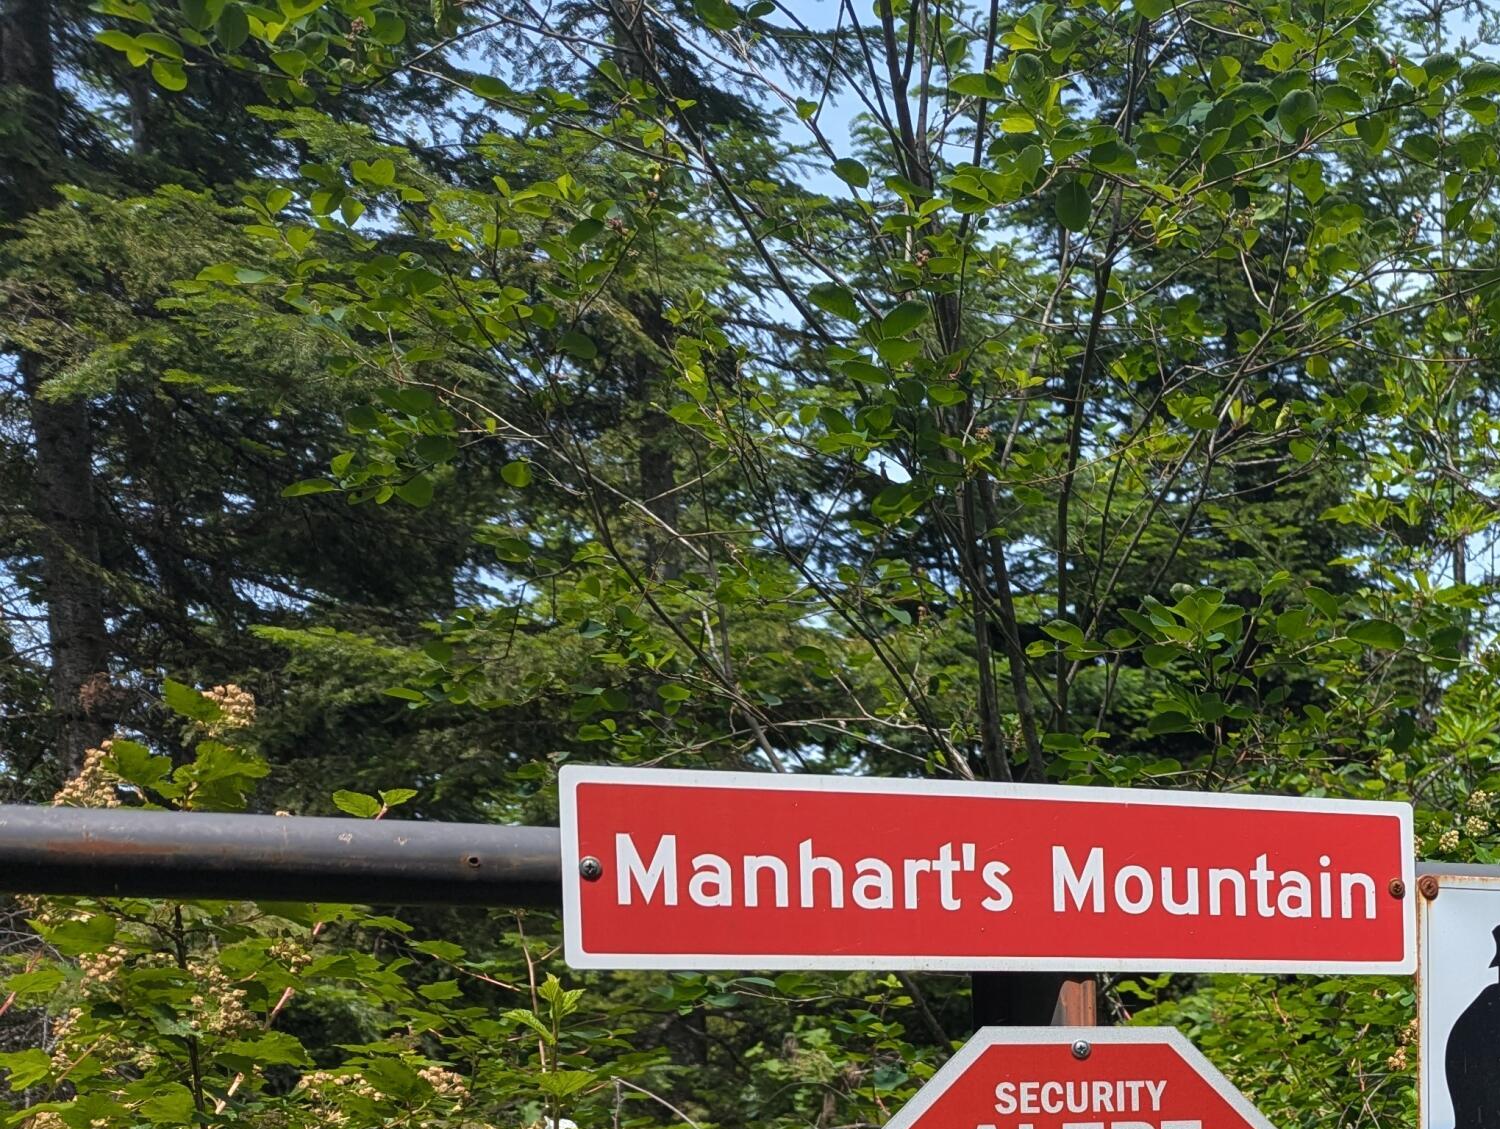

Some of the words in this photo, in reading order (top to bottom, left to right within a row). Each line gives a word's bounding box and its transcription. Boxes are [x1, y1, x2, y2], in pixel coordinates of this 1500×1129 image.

[614, 832, 1013, 912] Manhart's
[1052, 845, 1378, 921] Mountain
[994, 1080, 1168, 1115] SECURITY
